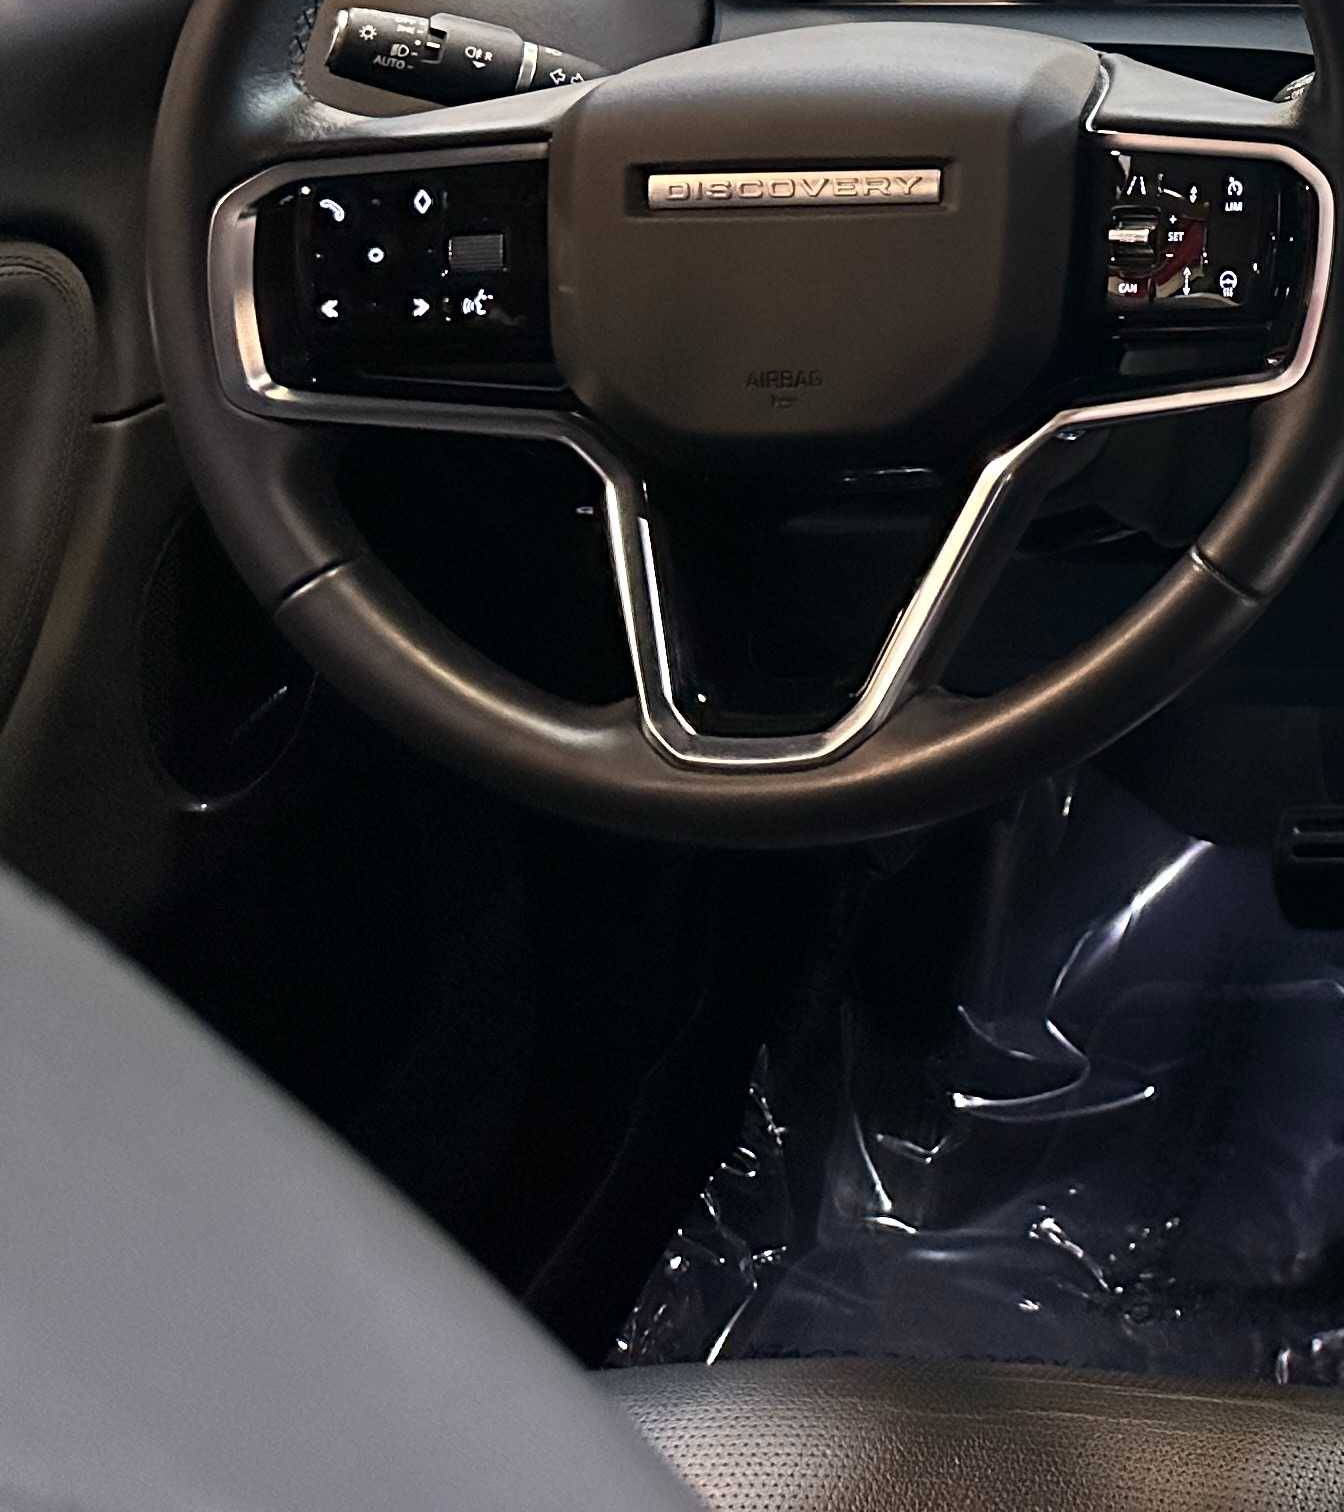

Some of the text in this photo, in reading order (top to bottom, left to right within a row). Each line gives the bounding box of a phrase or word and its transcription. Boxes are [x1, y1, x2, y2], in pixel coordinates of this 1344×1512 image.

[373, 54, 406, 69] AUTO
[665, 175, 923, 201] DISCOVERY
[1168, 231, 1184, 242] SET
[1118, 282, 1138, 294] CAN
[746, 368, 823, 389] AIRBAG
